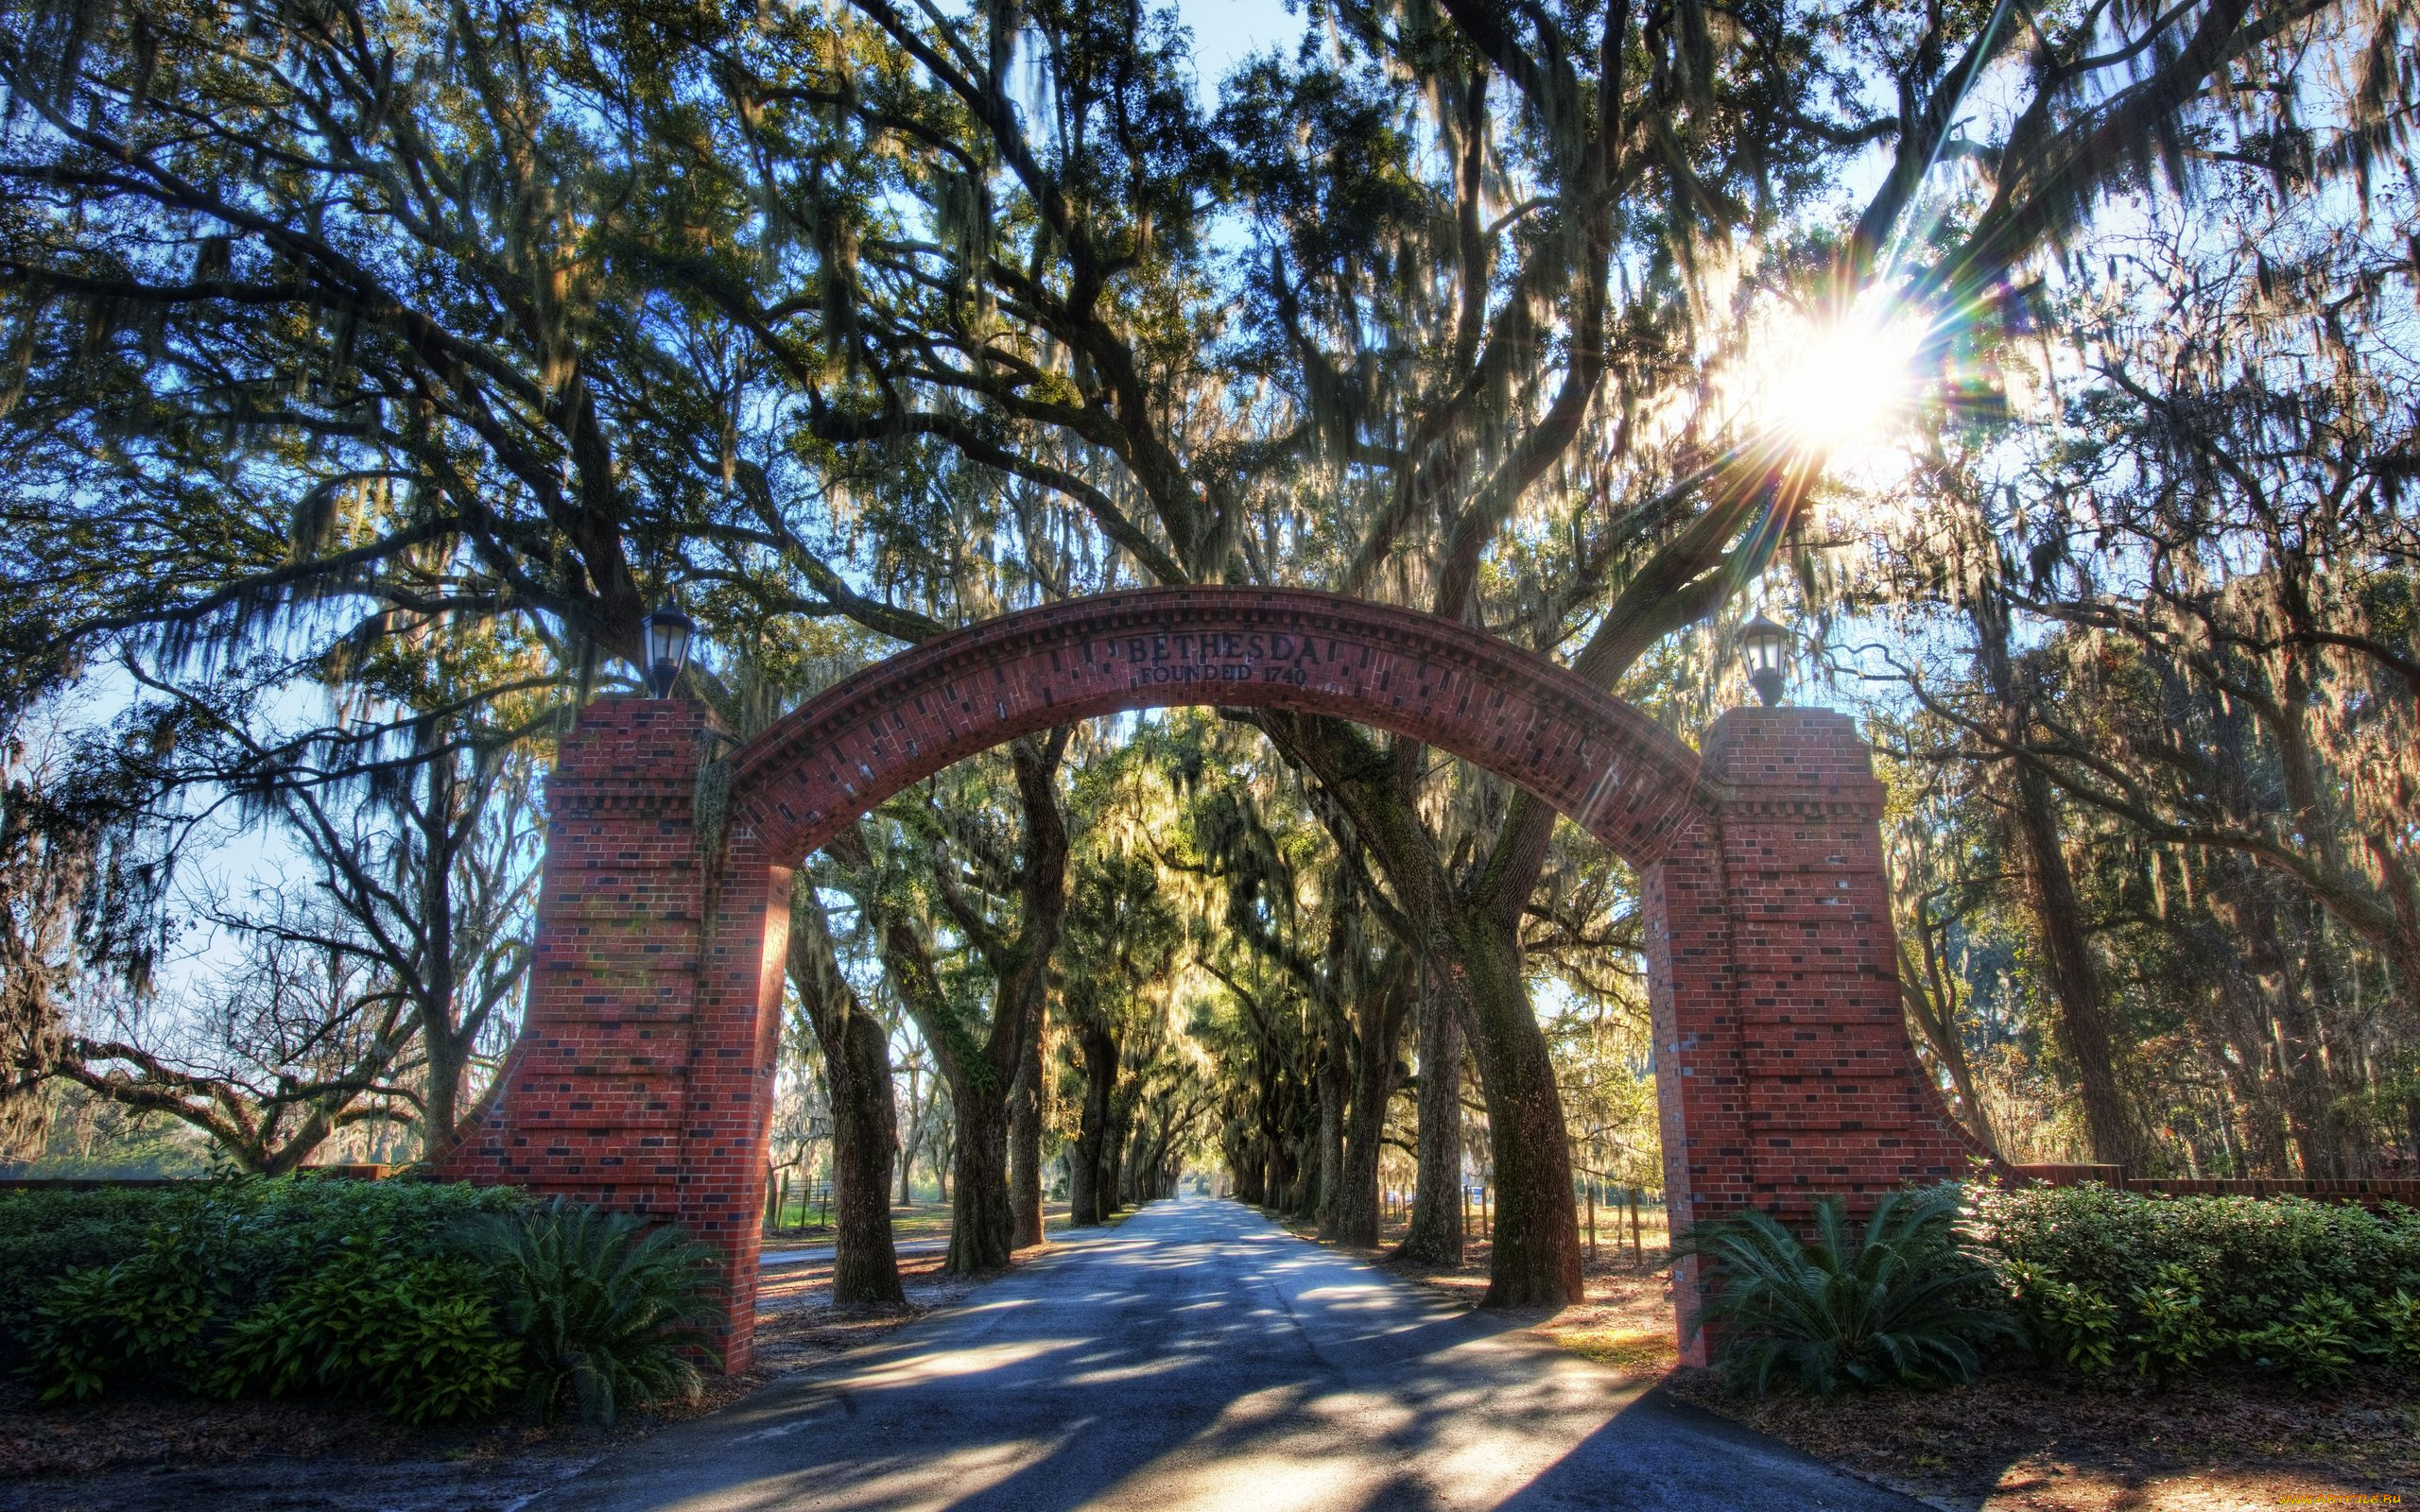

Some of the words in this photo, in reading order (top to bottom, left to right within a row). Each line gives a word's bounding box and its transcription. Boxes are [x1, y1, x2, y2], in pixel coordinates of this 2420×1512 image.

[1127, 632, 1321, 664] BETHESDA
[1140, 664, 1253, 684] FOUNDED
[1264, 665, 1307, 685] 1740
